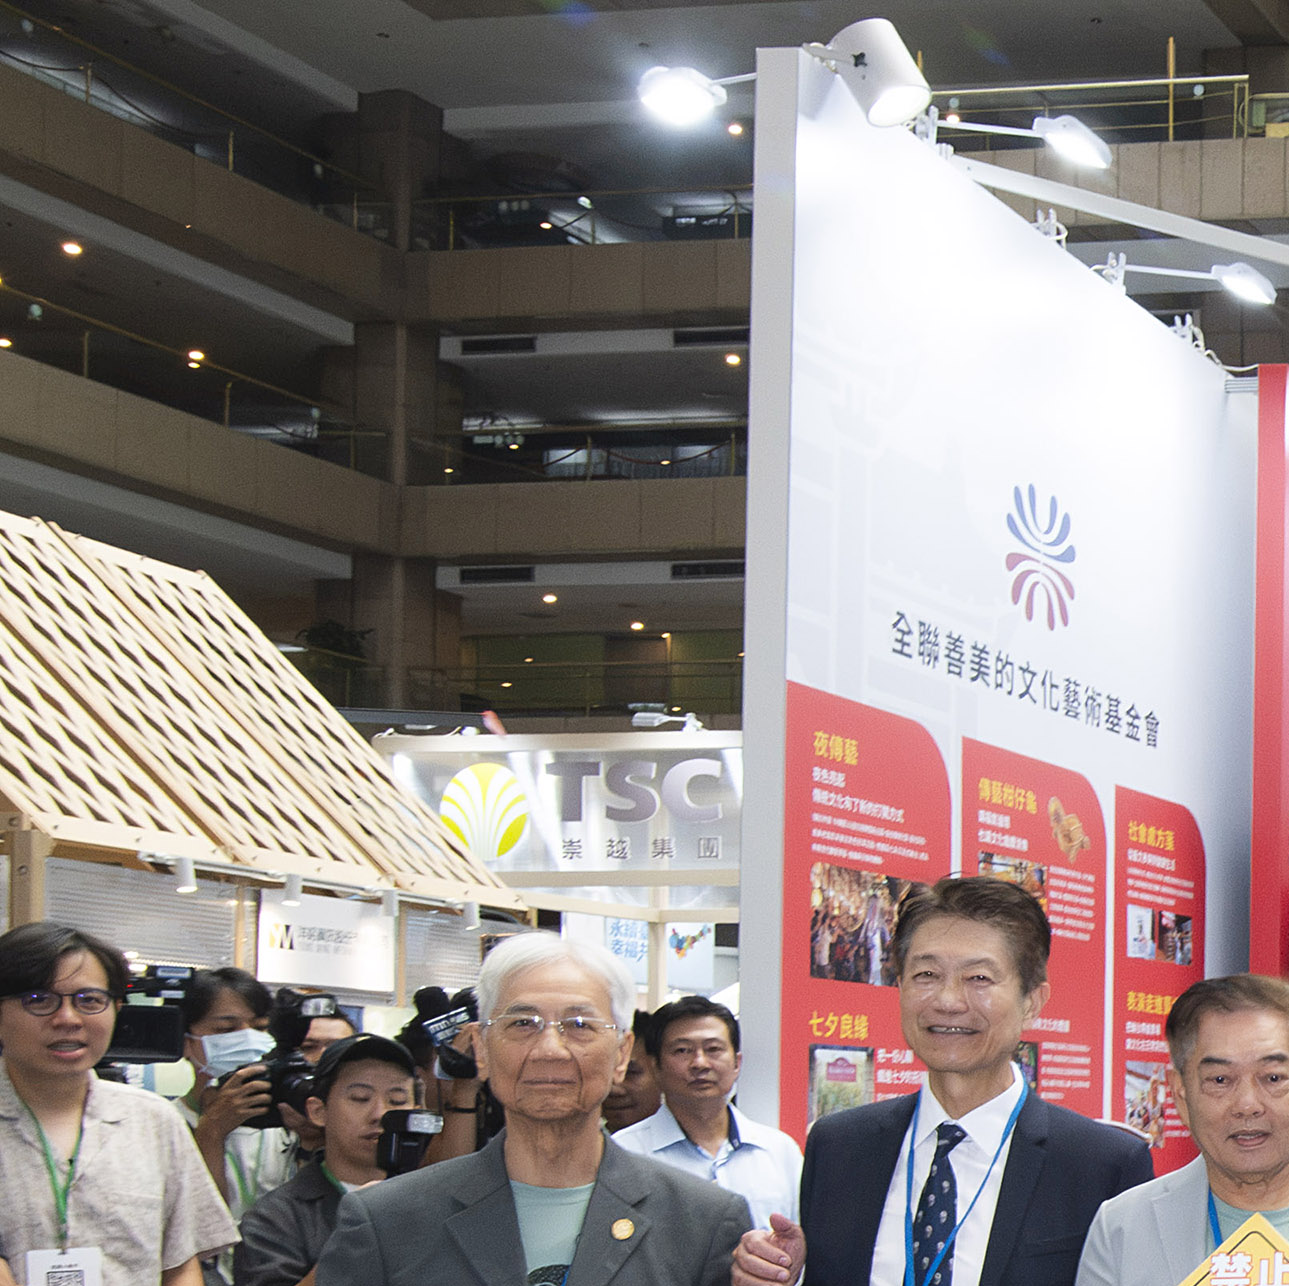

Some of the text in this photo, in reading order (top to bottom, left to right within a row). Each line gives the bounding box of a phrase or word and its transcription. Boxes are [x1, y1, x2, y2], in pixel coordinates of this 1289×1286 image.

[892, 611, 1160, 748] 全聯善美的文化藝術基金會
[545, 757, 723, 824] TSC
[561, 837, 722, 860] 崇越集團
[809, 1010, 869, 1040] 七夕良緣
